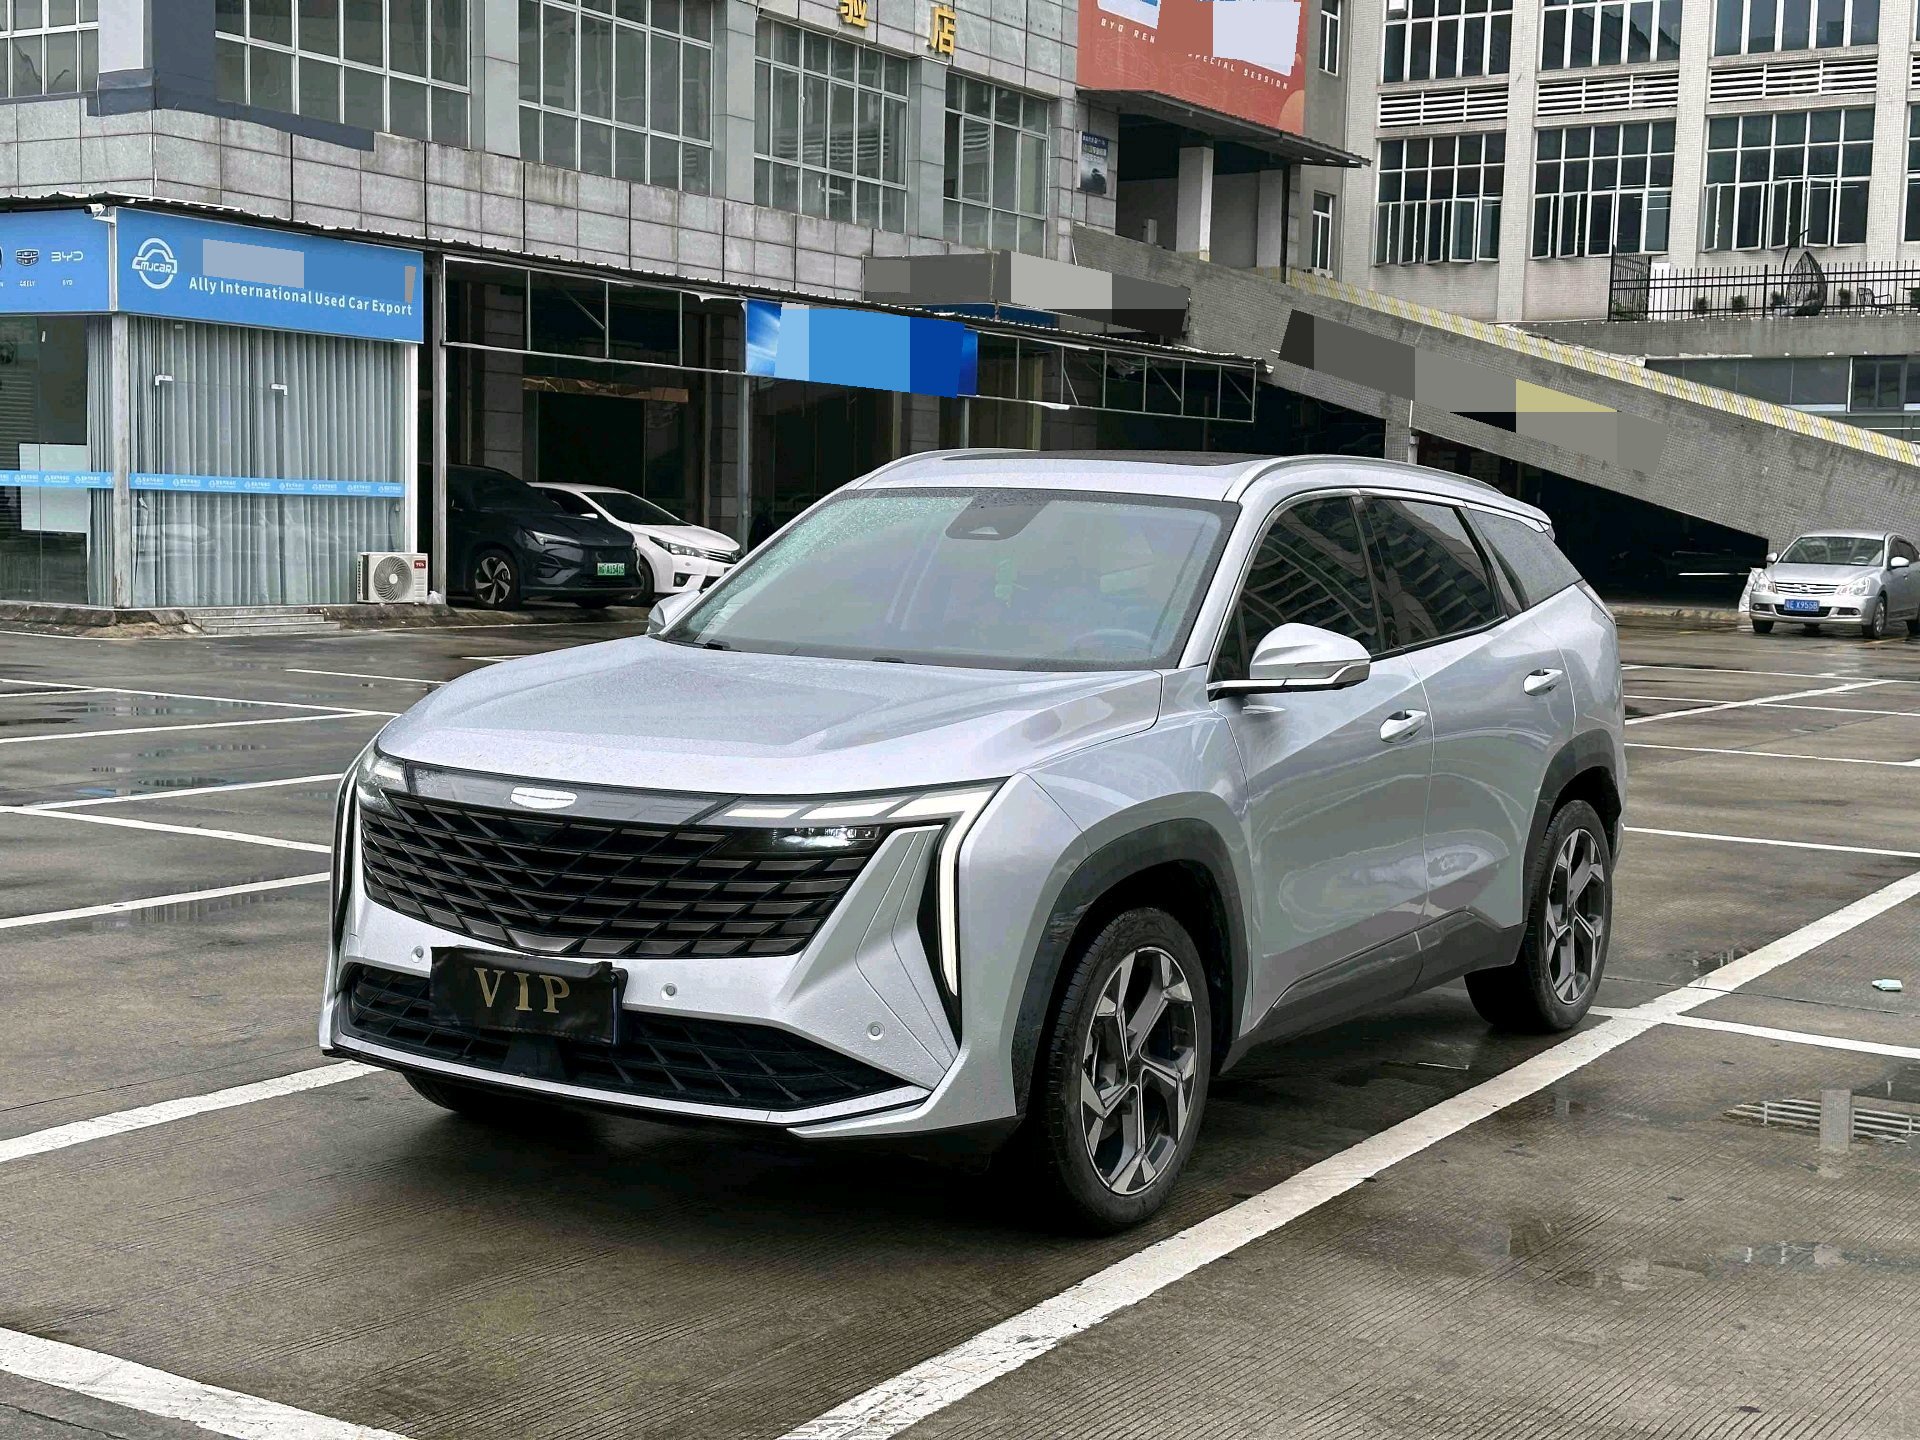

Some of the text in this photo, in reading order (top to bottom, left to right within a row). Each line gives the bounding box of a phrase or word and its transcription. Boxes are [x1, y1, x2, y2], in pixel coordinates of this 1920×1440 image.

[1243, 68, 1288, 90] SESSION
[189, 276, 412, 316] Ally International Used Car Export
[473, 967, 570, 1014] VIP
